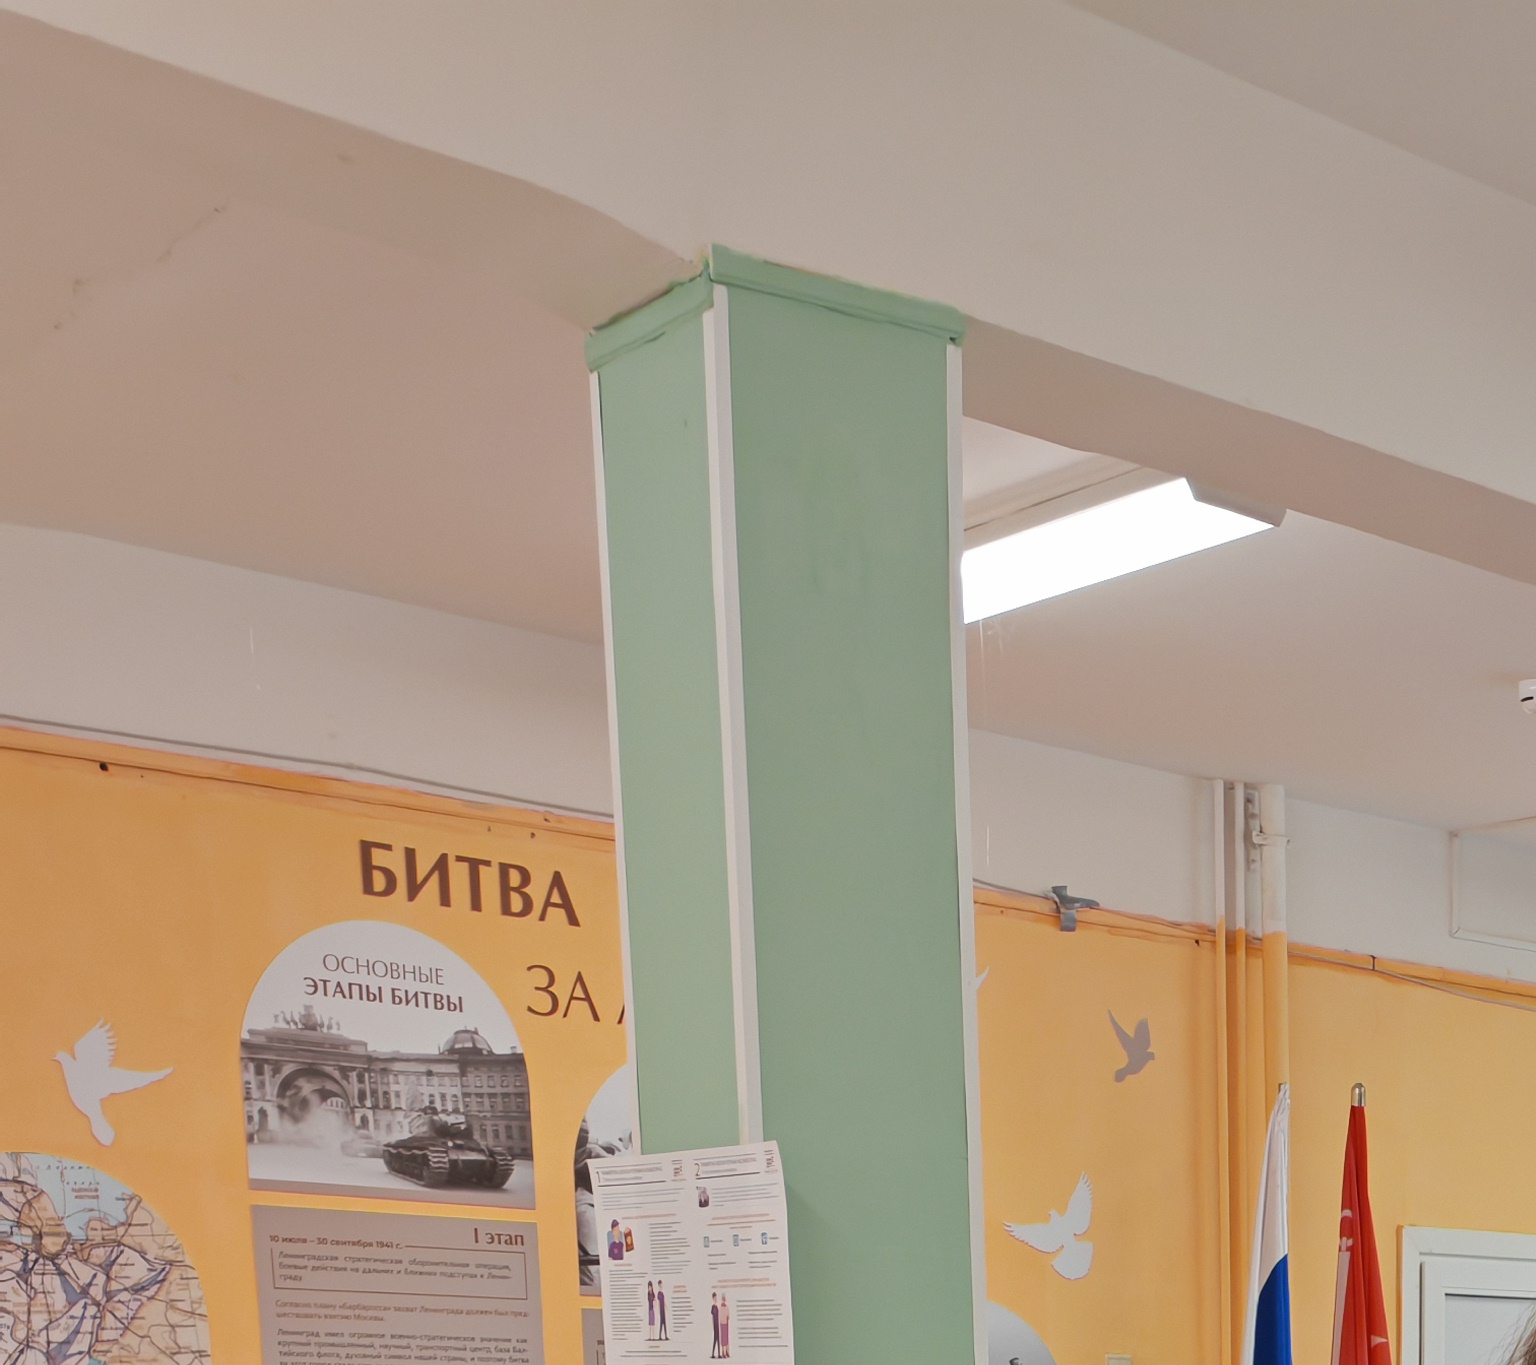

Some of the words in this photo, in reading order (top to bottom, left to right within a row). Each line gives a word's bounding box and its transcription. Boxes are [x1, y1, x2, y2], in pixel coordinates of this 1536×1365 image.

[360, 839, 581, 928] БИТВА
[323, 953, 445, 986] ОСНОВНЫЕ
[303, 977, 383, 1004] ЭТАПЫ
[391, 987, 463, 1013] БИТВЫ
[527, 965, 600, 1022] ЗА
[485, 1231, 525, 1246] этап
